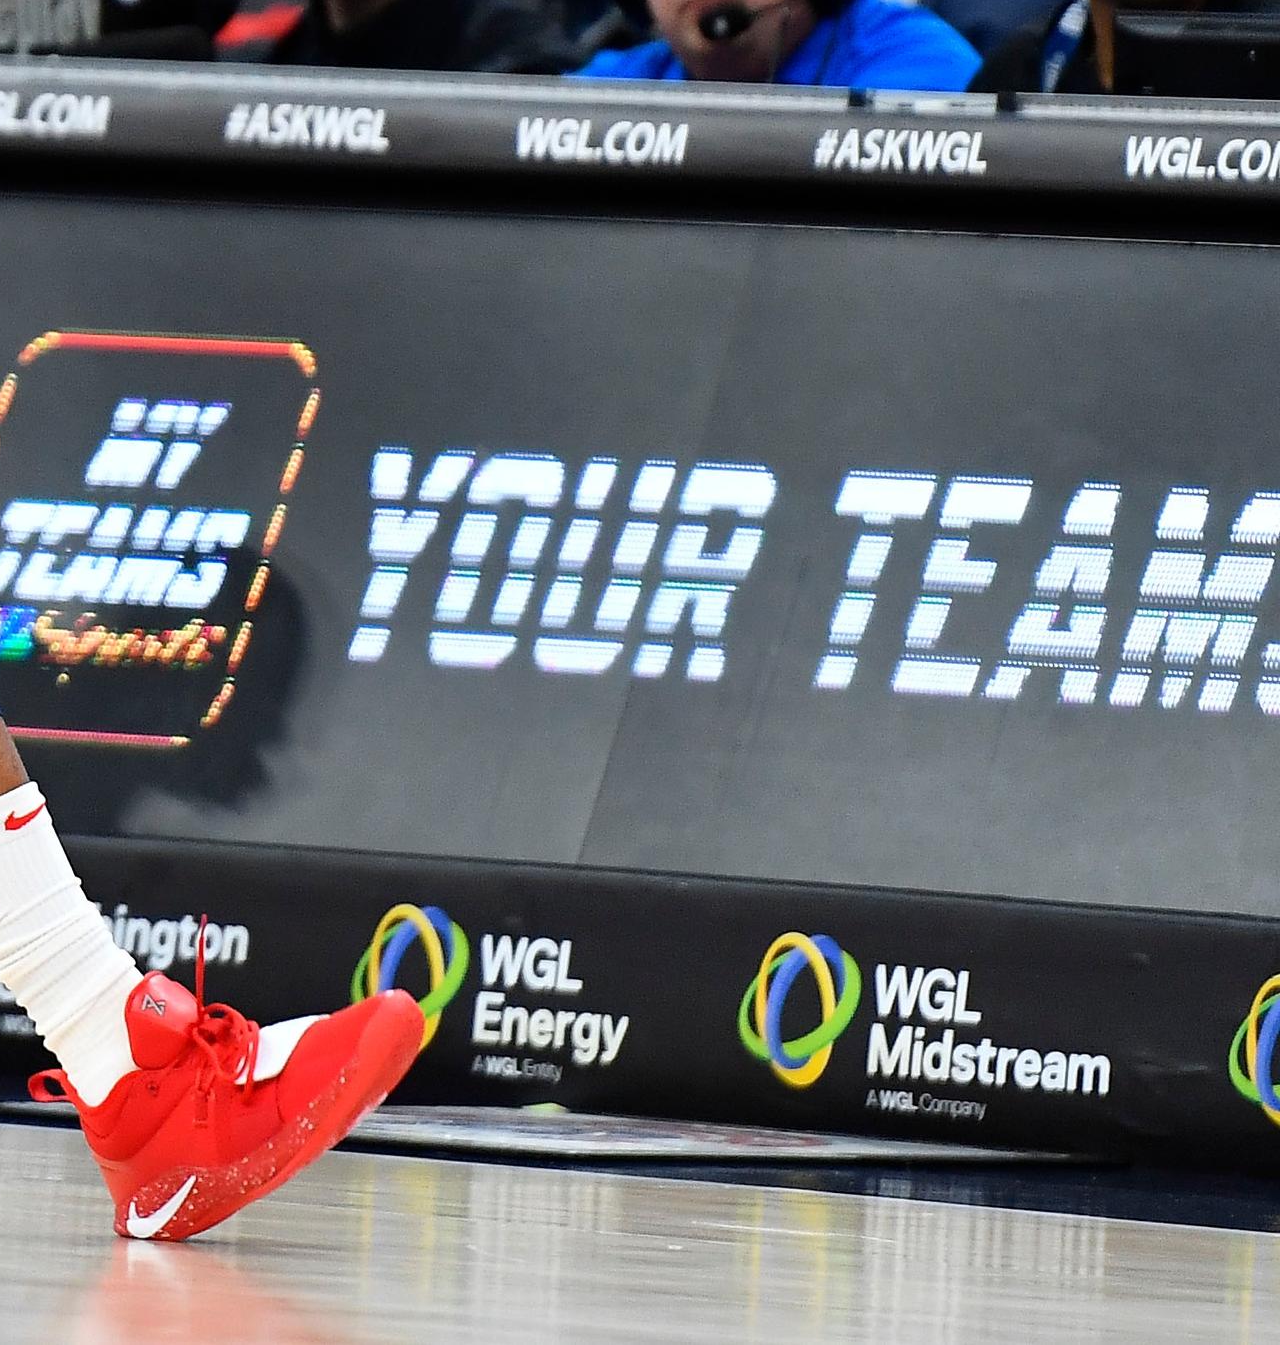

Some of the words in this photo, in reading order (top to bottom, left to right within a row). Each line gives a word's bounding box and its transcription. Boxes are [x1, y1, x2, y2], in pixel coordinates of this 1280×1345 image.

[224, 102, 390, 152] #ASKWGL
[515, 116, 690, 167] WGL.COM
[813, 127, 988, 175] #ASKWGL
[1125, 135, 1280, 182] WGL.CO
[347, 446, 778, 683] YOUR
[812, 468, 1280, 715] TEAM
[480, 933, 583, 994] WGL
[874, 963, 982, 1025] WGL
[472, 991, 630, 1066] Energy
[485, 1055, 522, 1077] WGL
[866, 1022, 1111, 1096] Midstream
[865, 1088, 880, 1107] A
[880, 1089, 919, 1112] WGL
[919, 1092, 988, 1121] Company
